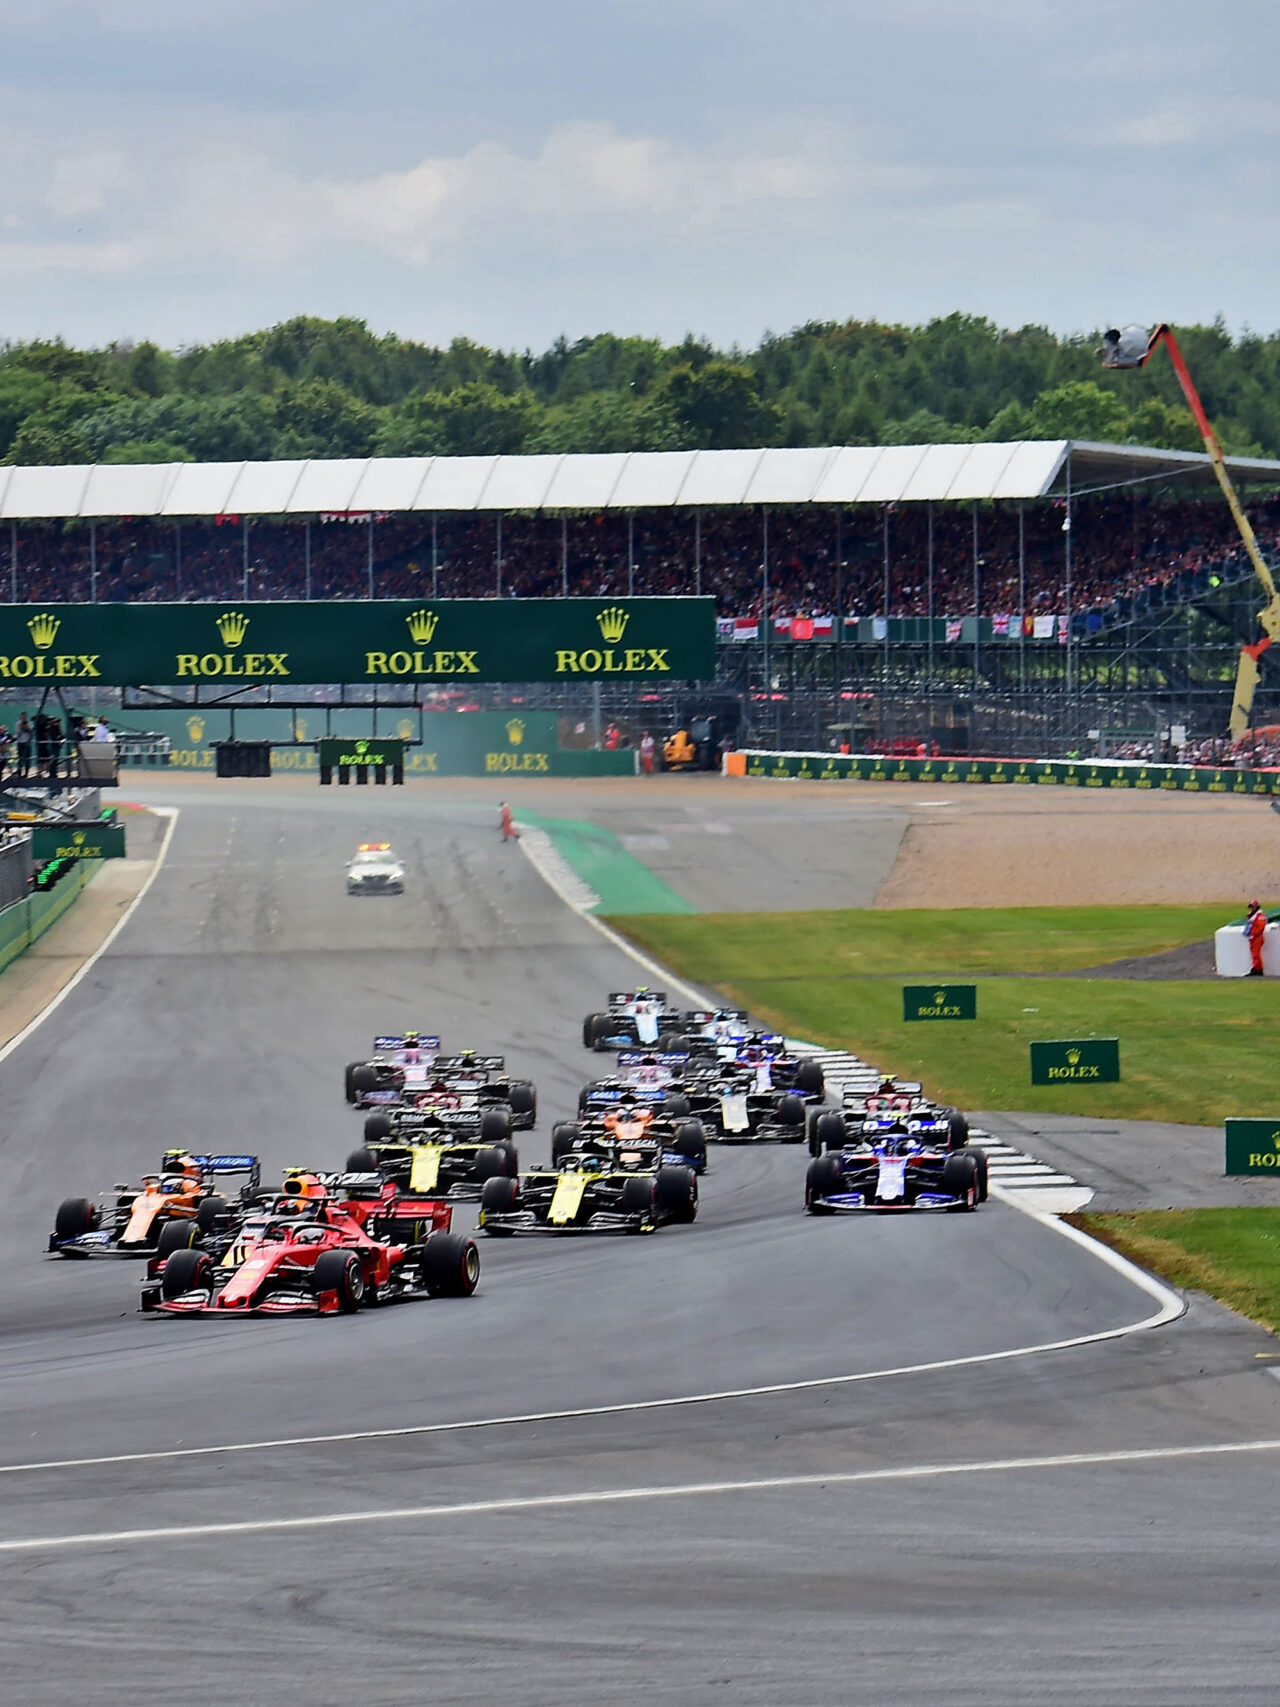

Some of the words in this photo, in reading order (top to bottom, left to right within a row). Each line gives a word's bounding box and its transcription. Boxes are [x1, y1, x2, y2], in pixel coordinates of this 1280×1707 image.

[176, 652, 290, 676] ROLEX
[365, 650, 480, 675] ROLEX
[556, 648, 670, 673] ROLEX
[169, 750, 214, 767] ROLE
[270, 751, 318, 769] ROLE
[485, 753, 549, 771] ROLEX
[918, 1005, 961, 1016] ROLEX
[1048, 1066, 1099, 1079] ROLEX
